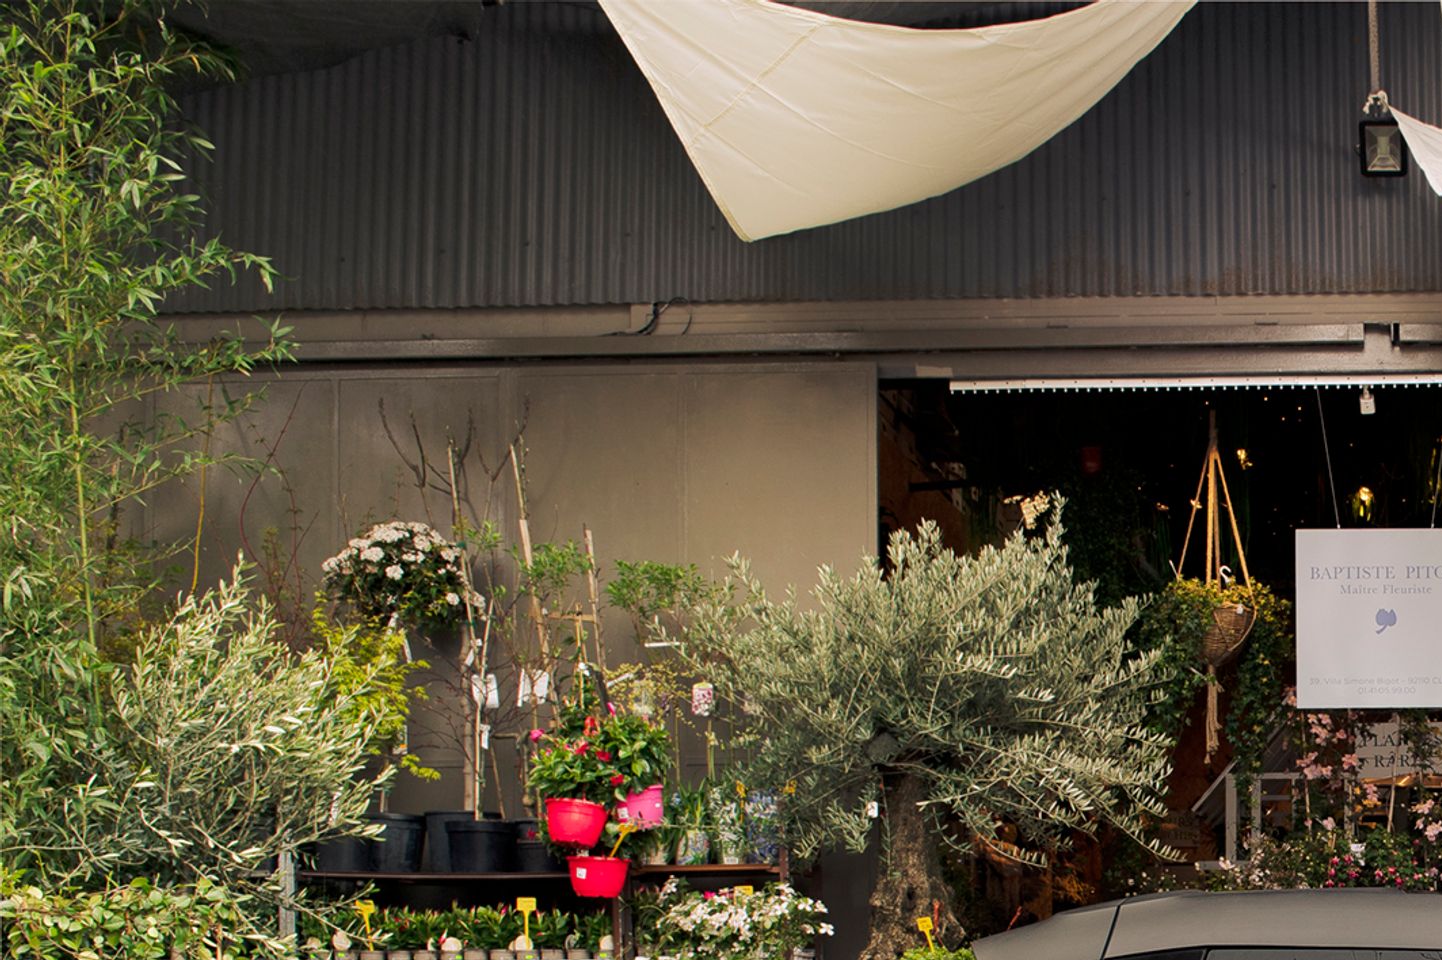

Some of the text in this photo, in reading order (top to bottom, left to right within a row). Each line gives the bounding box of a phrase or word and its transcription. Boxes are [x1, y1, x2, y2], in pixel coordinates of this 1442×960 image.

[1310, 566, 1396, 580] BAPTISTE
[1340, 584, 1433, 594] Maître Fleuriste
